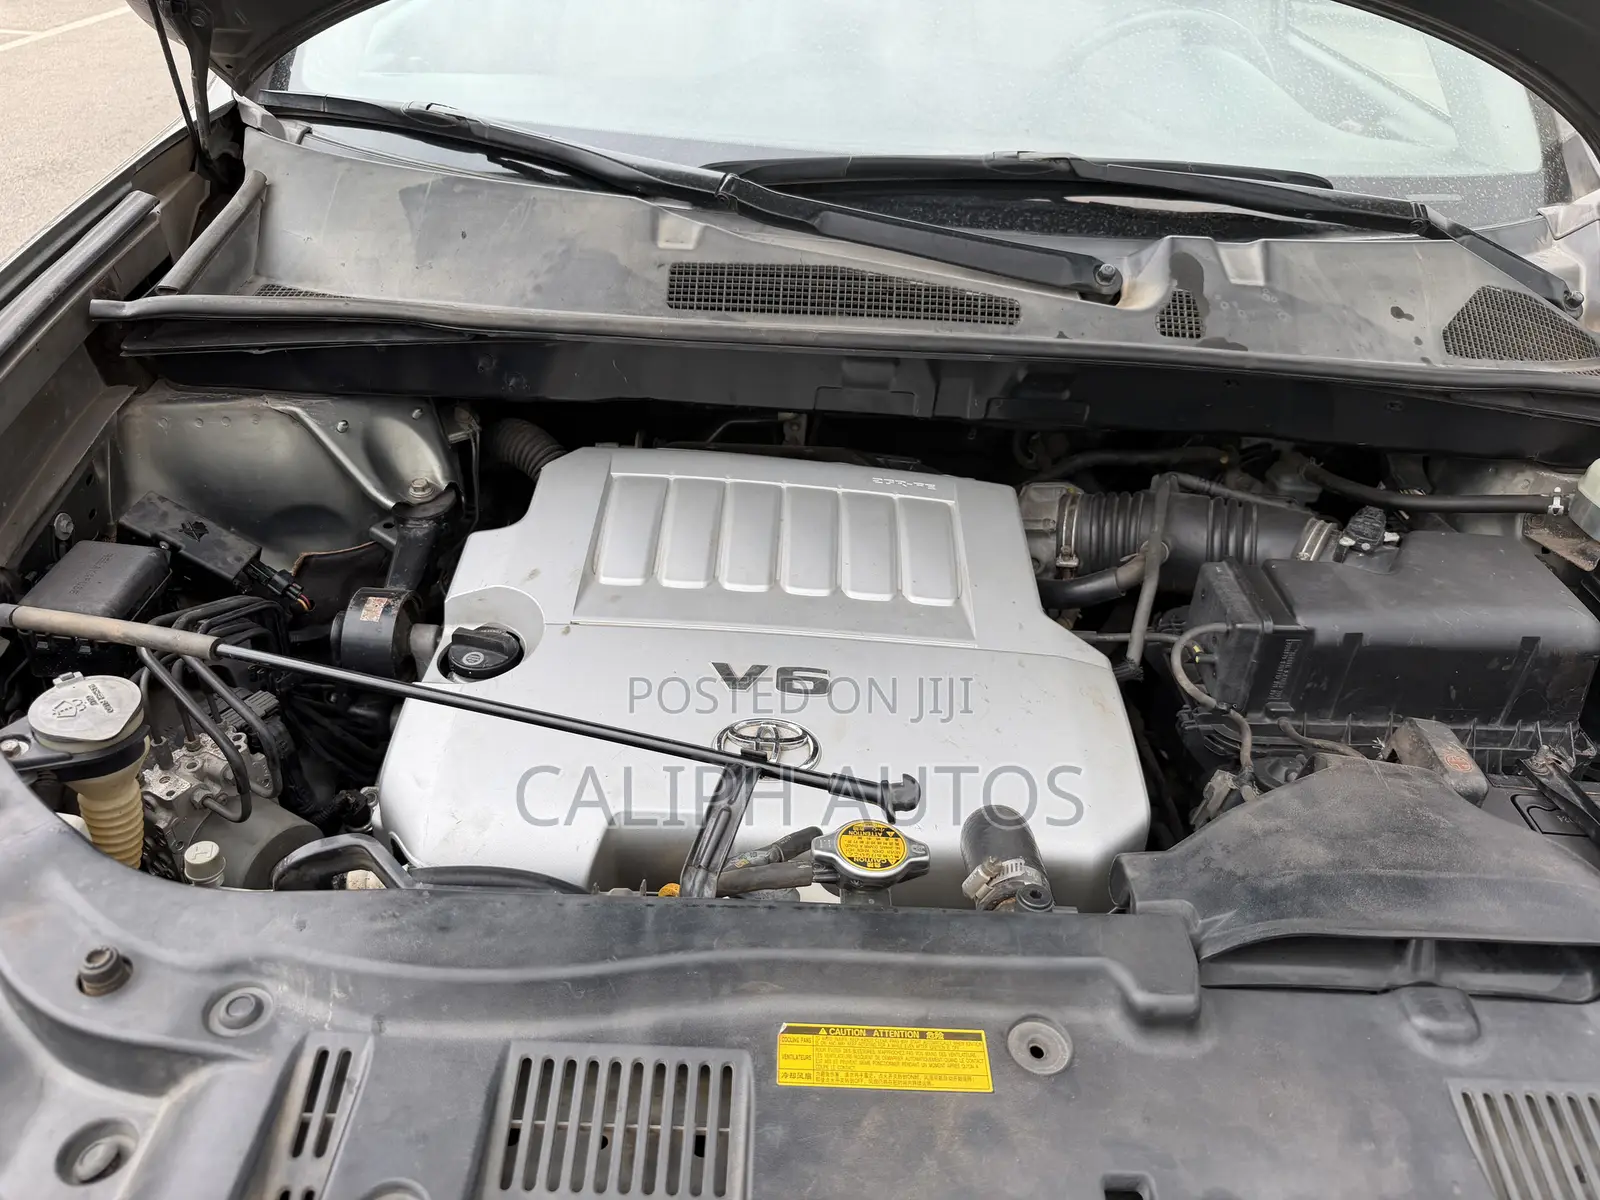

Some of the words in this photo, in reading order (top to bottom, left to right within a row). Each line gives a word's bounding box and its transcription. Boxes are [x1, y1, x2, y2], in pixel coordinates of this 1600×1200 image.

[709, 660, 831, 697] V6
[829, 1028, 866, 1037] CAUTION
[873, 1029, 920, 1039] ATTENTION
